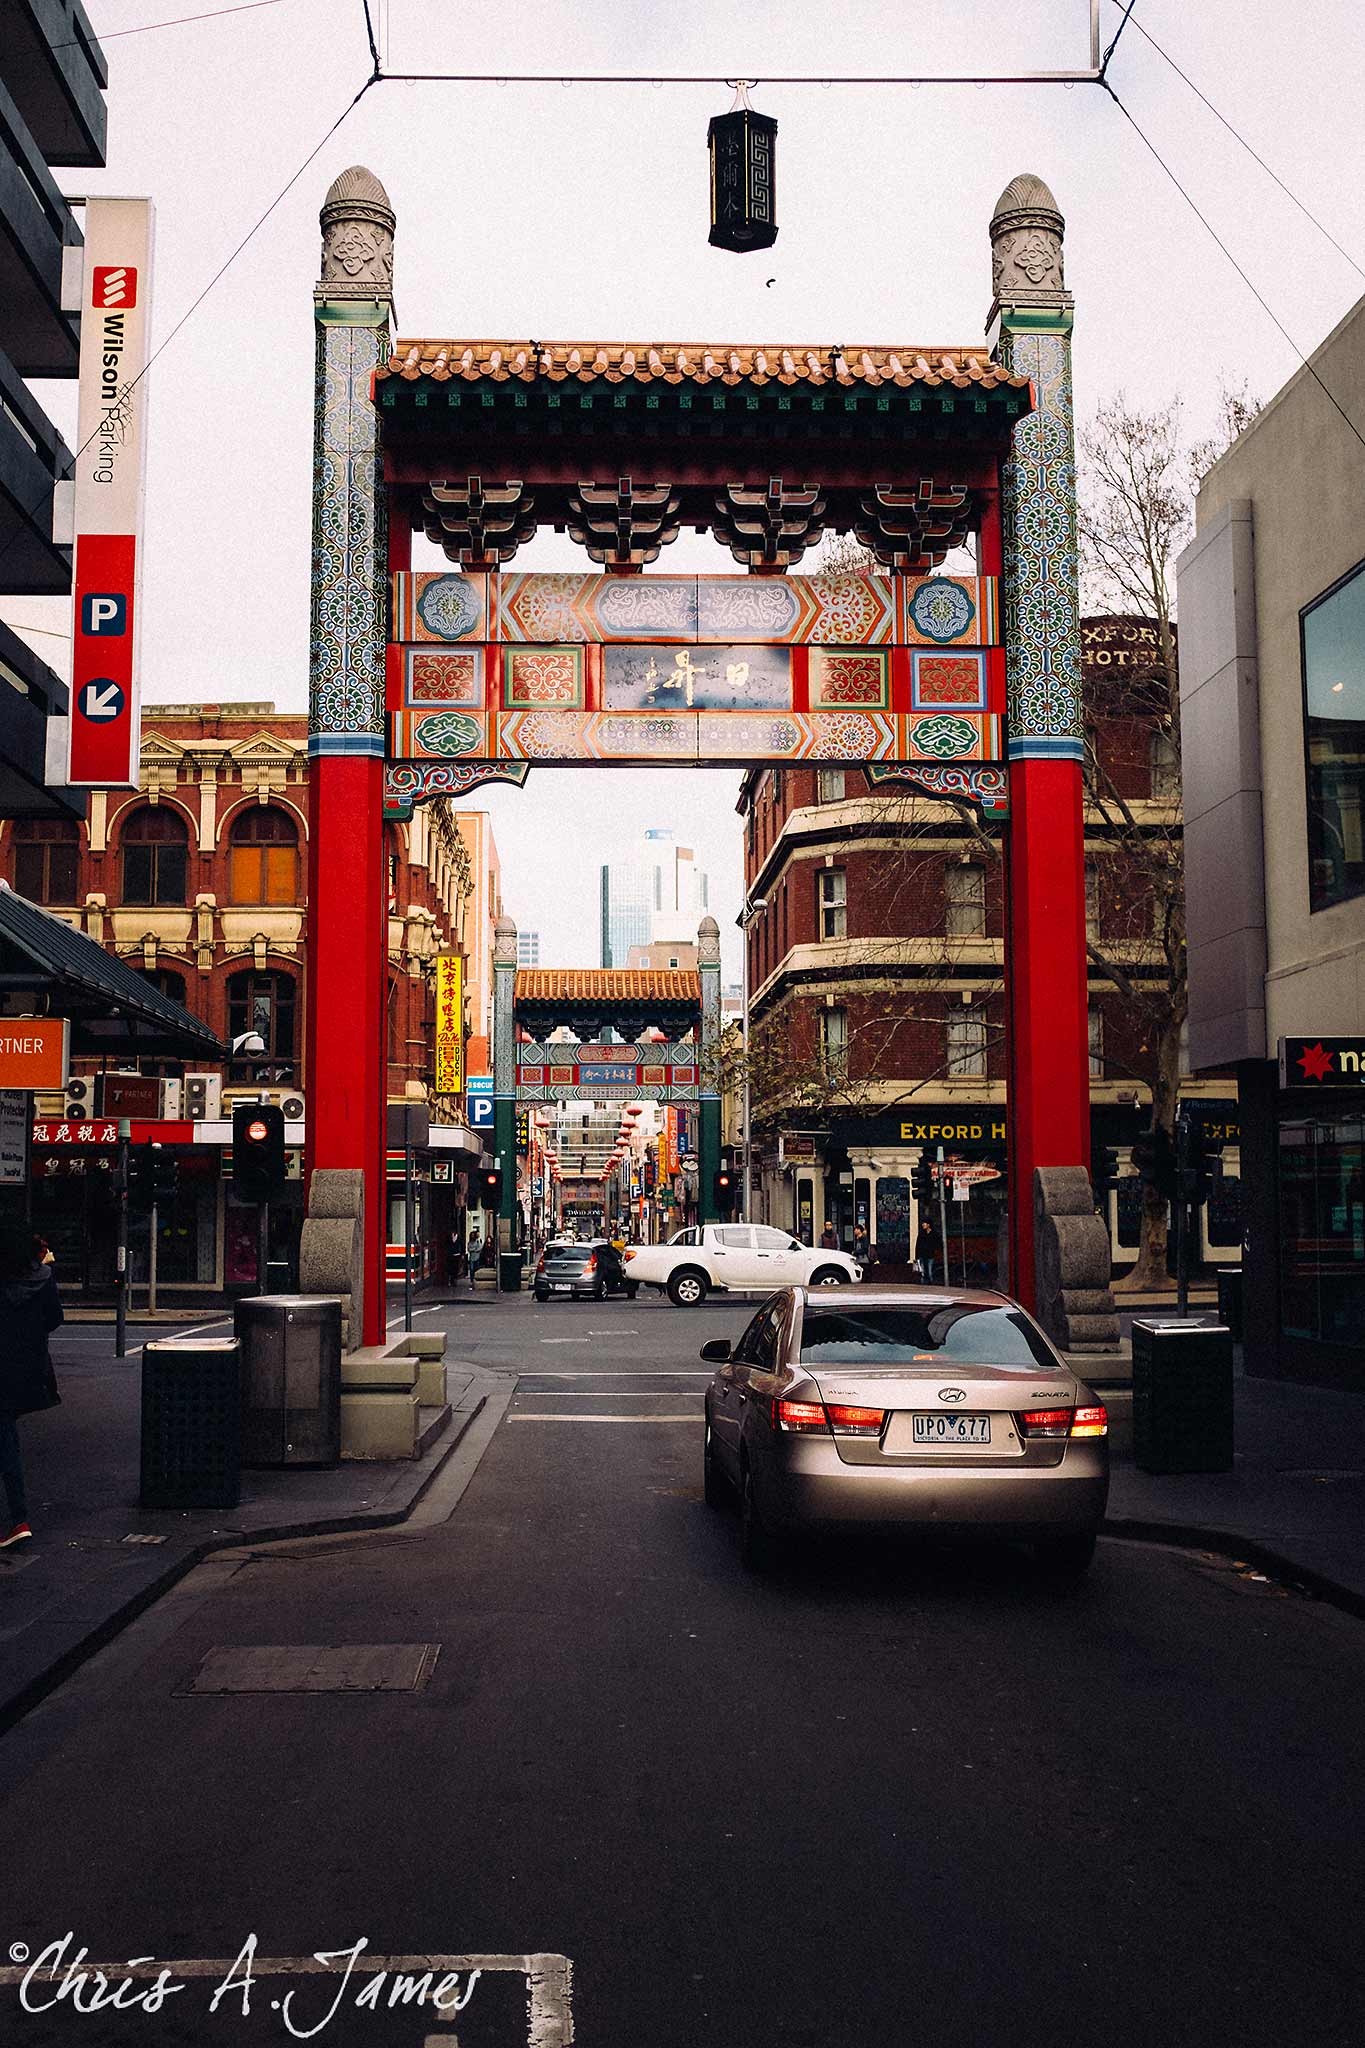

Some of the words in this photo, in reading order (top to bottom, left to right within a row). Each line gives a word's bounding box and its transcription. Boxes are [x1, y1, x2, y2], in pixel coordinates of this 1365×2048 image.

[102, 312, 125, 399] Wilson
[93, 407, 120, 484] Parking
[91, 597, 118, 631] P
[474, 1099, 493, 1122] P
[900, 1122, 983, 1140] EXFORD
[958, 1418, 987, 1435] 677
